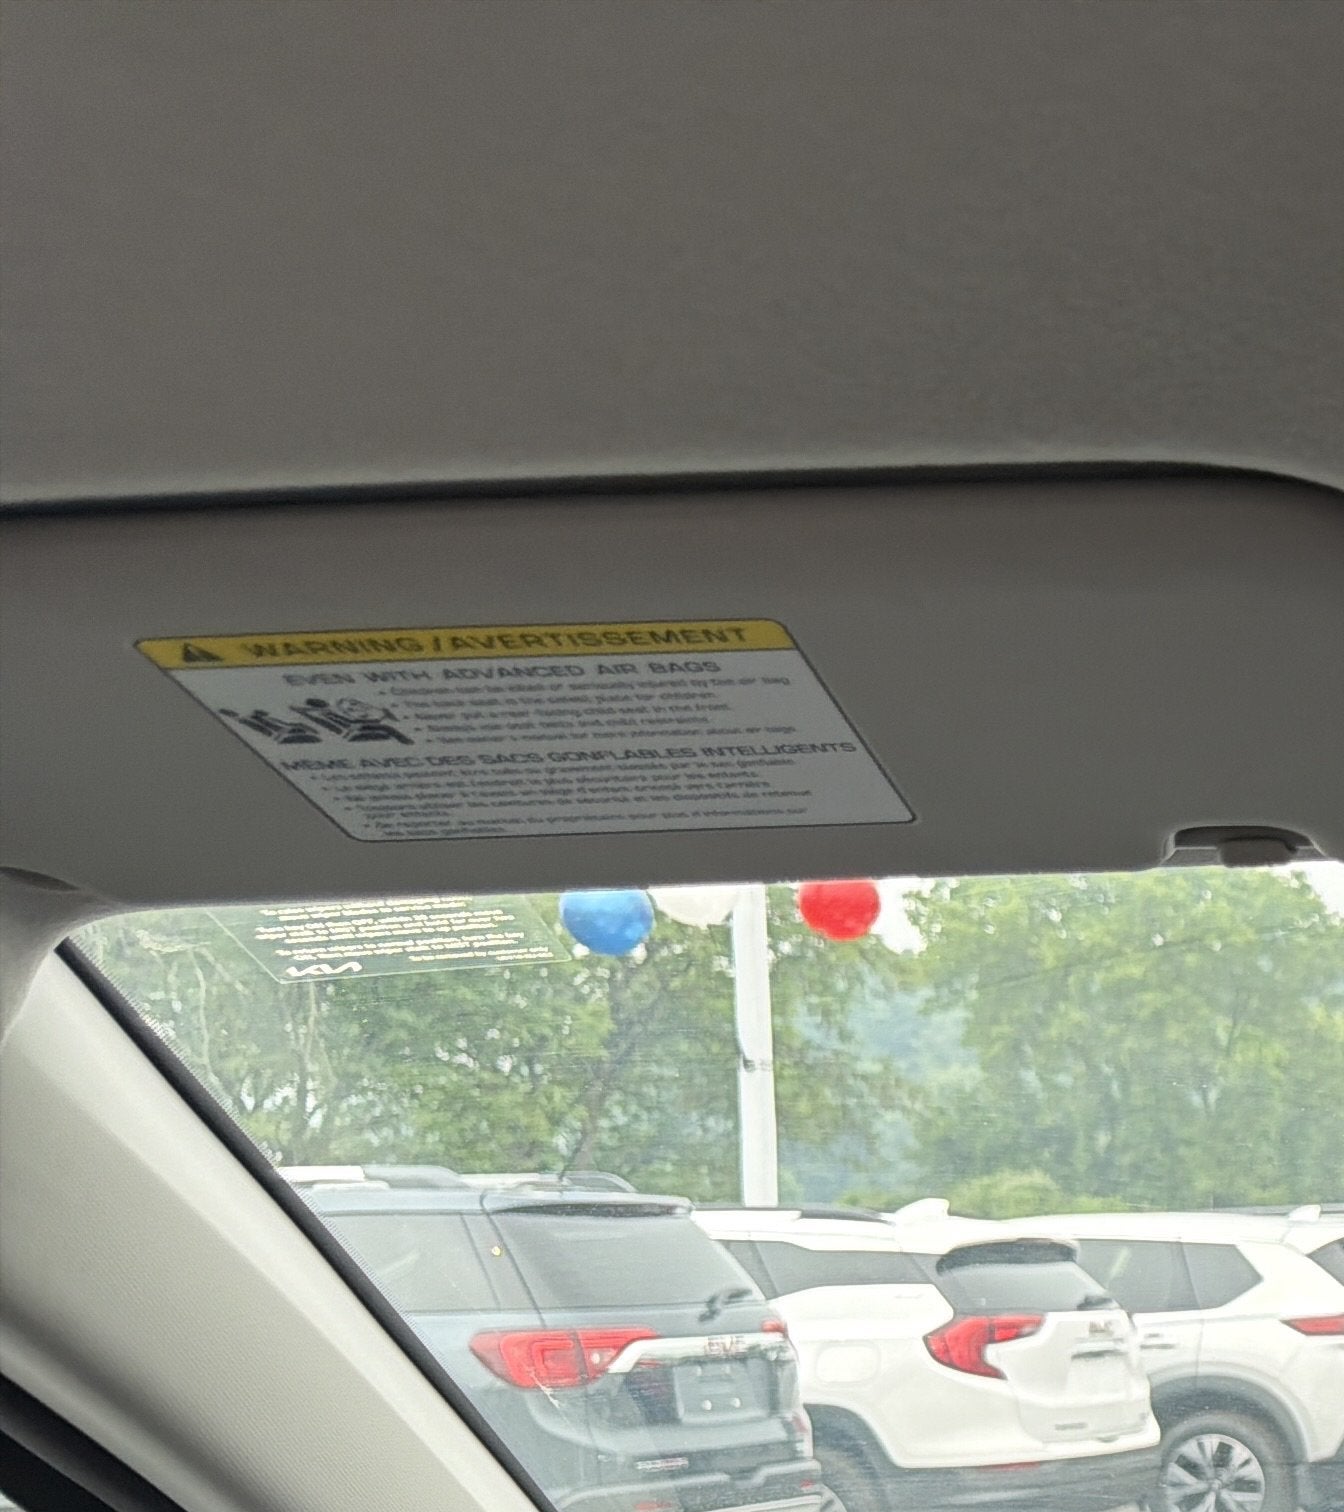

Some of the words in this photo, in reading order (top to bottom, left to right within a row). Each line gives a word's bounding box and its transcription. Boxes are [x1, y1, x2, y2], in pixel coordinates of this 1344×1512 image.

[282, 673, 356, 686] EVEN
[362, 670, 434, 683] WITH
[442, 664, 585, 680] ADVANCED
[597, 662, 638, 676] AIR
[648, 661, 722, 674] BAGS
[480, 752, 544, 765] SACS
[702, 742, 857, 758] INTELLIGENTS
